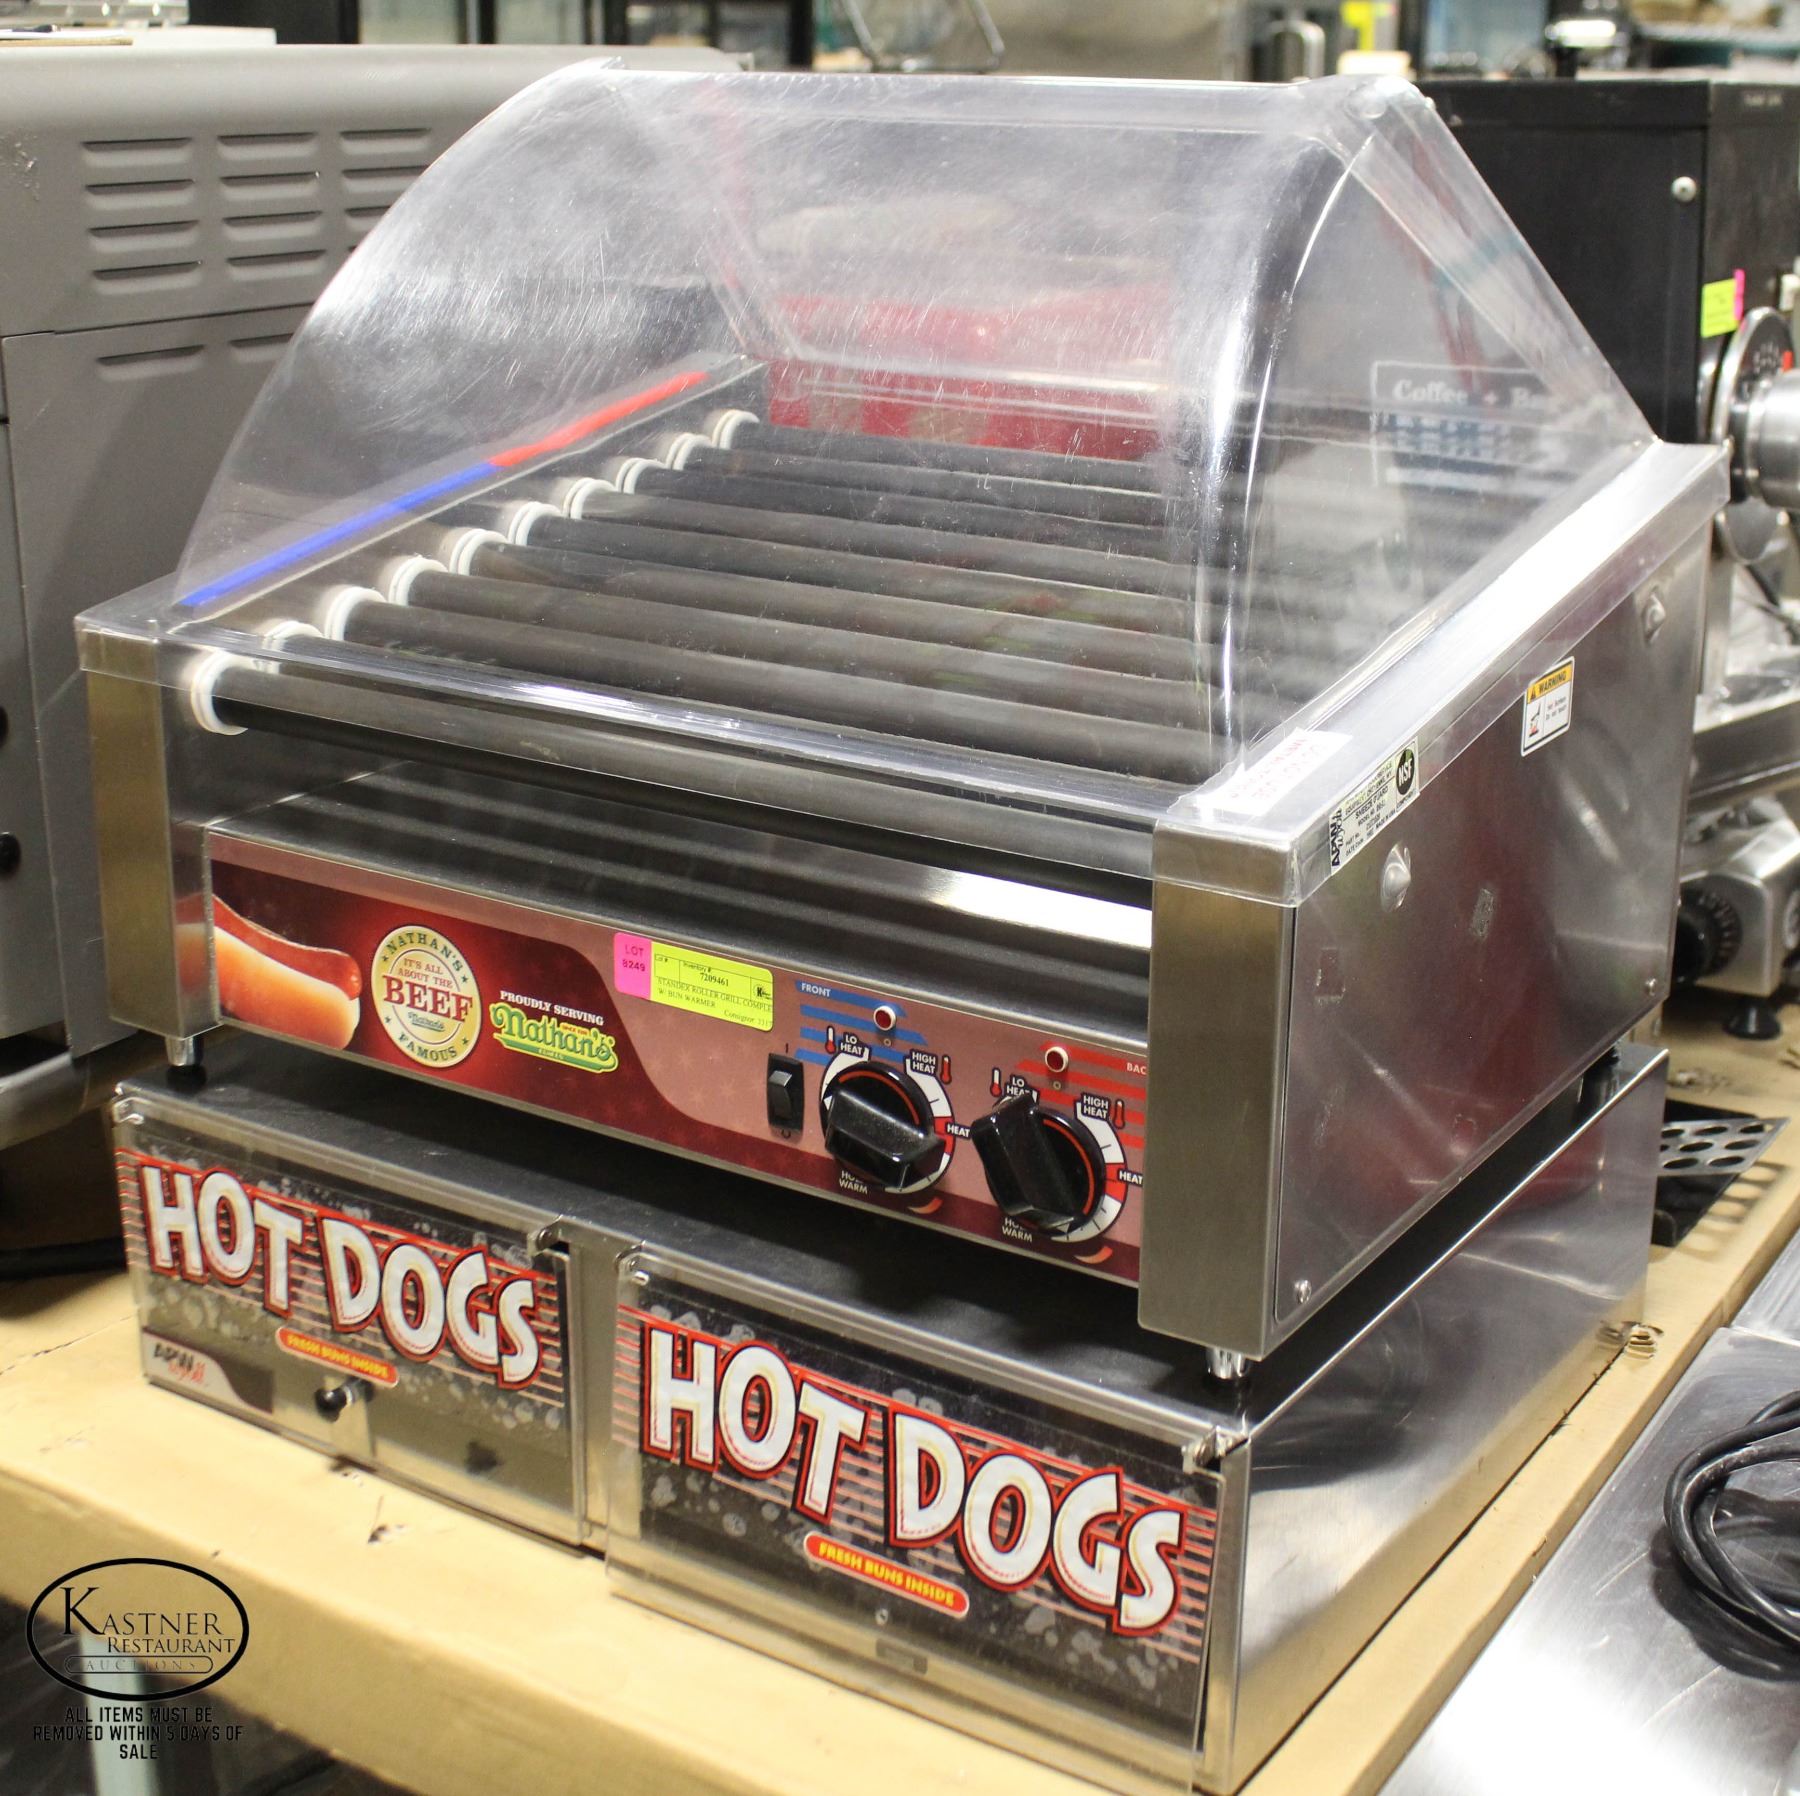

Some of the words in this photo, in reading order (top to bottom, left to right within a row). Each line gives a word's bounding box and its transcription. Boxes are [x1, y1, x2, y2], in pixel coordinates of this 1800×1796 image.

[1539, 670, 1567, 695] WARNING
[1398, 759, 1413, 788] NSF
[386, 931, 463, 972] NATHAN'S
[624, 944, 645, 958] LOT
[403, 957, 422, 970] IT'S
[424, 961, 444, 975] ALL
[622, 958, 646, 973] 8249
[398, 967, 430, 983] ABOUT
[432, 975, 454, 989] THE
[700, 972, 729, 987] 7209461
[382, 974, 473, 1023] BEEF
[801, 982, 831, 998] FRONT
[500, 990, 552, 1012] PROUDLY
[553, 1003, 605, 1026] SERVING
[491, 1004, 616, 1061] Nathan's
[845, 1034, 857, 1046] LO
[398, 1032, 458, 1062] FAMOUS
[840, 1041, 863, 1056] HEAT
[912, 1051, 936, 1066] HIGH
[912, 1061, 936, 1075] HEAT
[1126, 1061, 1147, 1076] BAC
[1012, 1076, 1025, 1088] LO
[1083, 1095, 1110, 1109] HIGH
[1083, 1105, 1108, 1118] HEAT
[947, 1124, 970, 1137] HEAT
[838, 1177, 868, 1195] WARM
[1119, 1170, 1144, 1185] HEAT
[1002, 1224, 1033, 1243] WARM
[140, 1164, 303, 1313] HOT
[321, 1215, 540, 1384] DOGS
[647, 1325, 871, 1517] HOT
[892, 1410, 1186, 1632] DOGS
[818, 1541, 863, 1570] FRESH
[864, 1558, 904, 1587] BUNS
[905, 1575, 956, 1608] INSIDE
